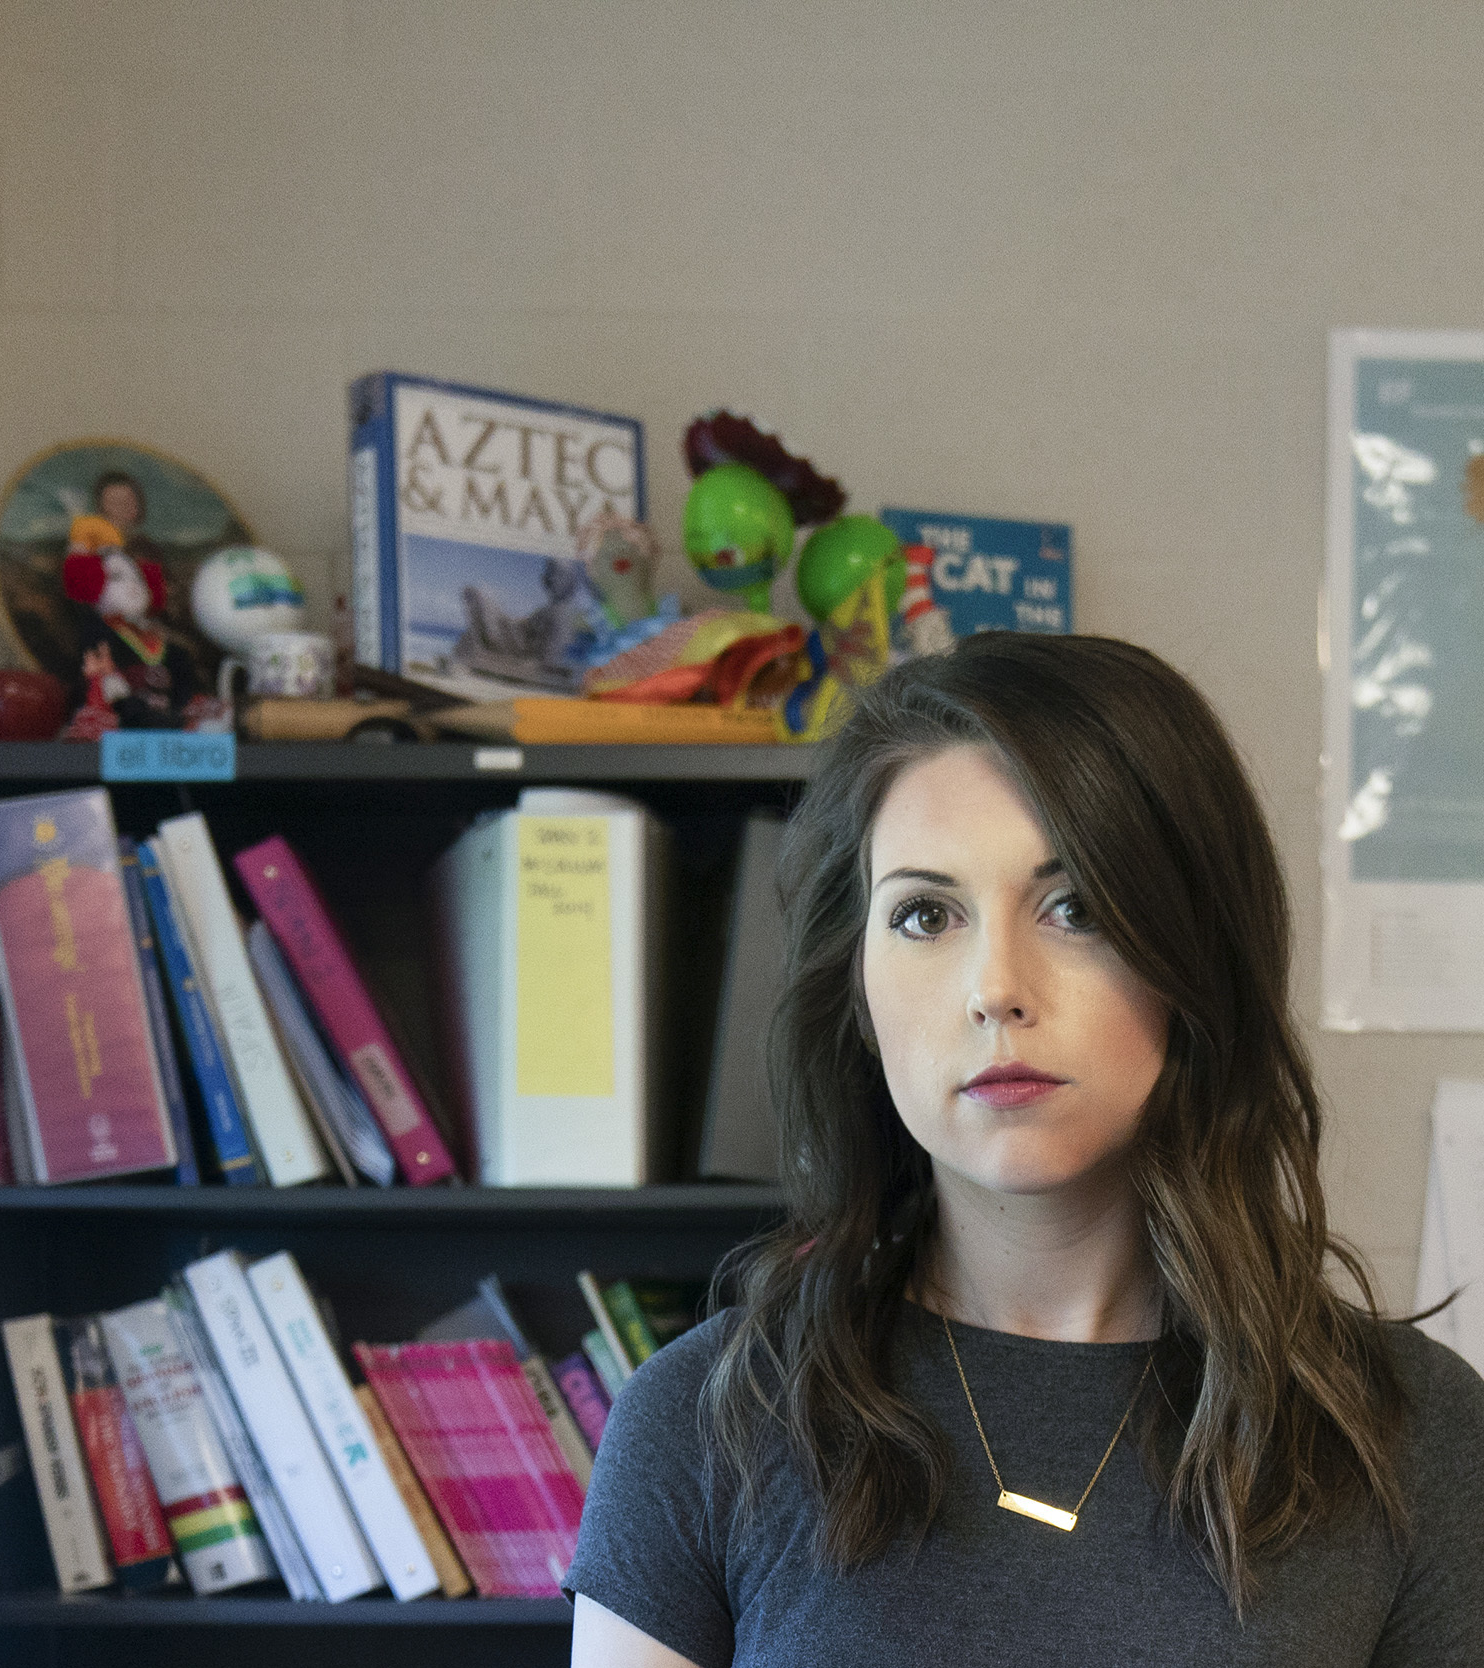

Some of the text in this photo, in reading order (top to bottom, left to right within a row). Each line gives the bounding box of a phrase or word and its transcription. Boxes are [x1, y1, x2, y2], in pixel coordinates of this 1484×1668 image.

[407, 408, 633, 497] AZTEC
[400, 459, 447, 516] &
[919, 526, 970, 550] THE
[932, 553, 1057, 599] CAT IN
[1015, 602, 1062, 628] THE
[119, 740, 230, 769] el libro
